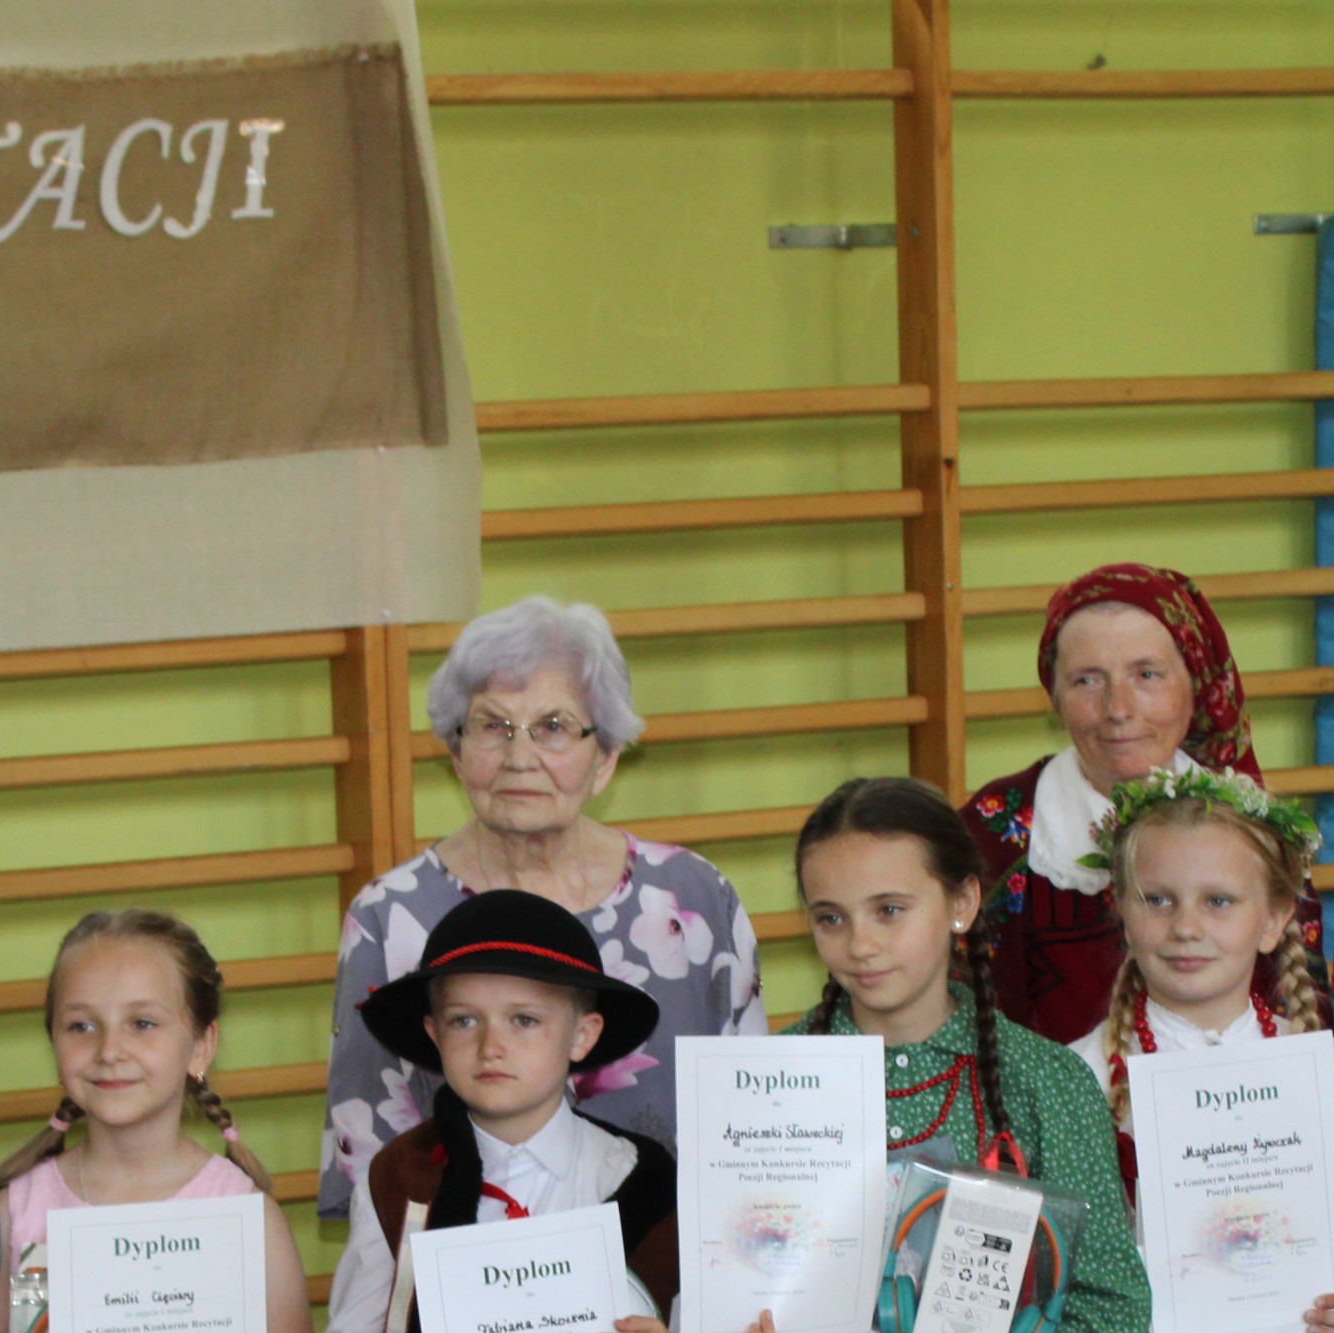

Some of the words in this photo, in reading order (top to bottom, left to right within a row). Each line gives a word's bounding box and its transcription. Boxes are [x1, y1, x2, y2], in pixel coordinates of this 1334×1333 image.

[736, 1070, 820, 1095] Dyplom
[1195, 1085, 1279, 1111] Dyplom
[723, 1123, 782, 1147] Agnieszki
[1182, 1142, 1248, 1162] Magdaleny
[114, 1235, 200, 1261] Dyplom
[483, 1260, 571, 1288] Dyplom
